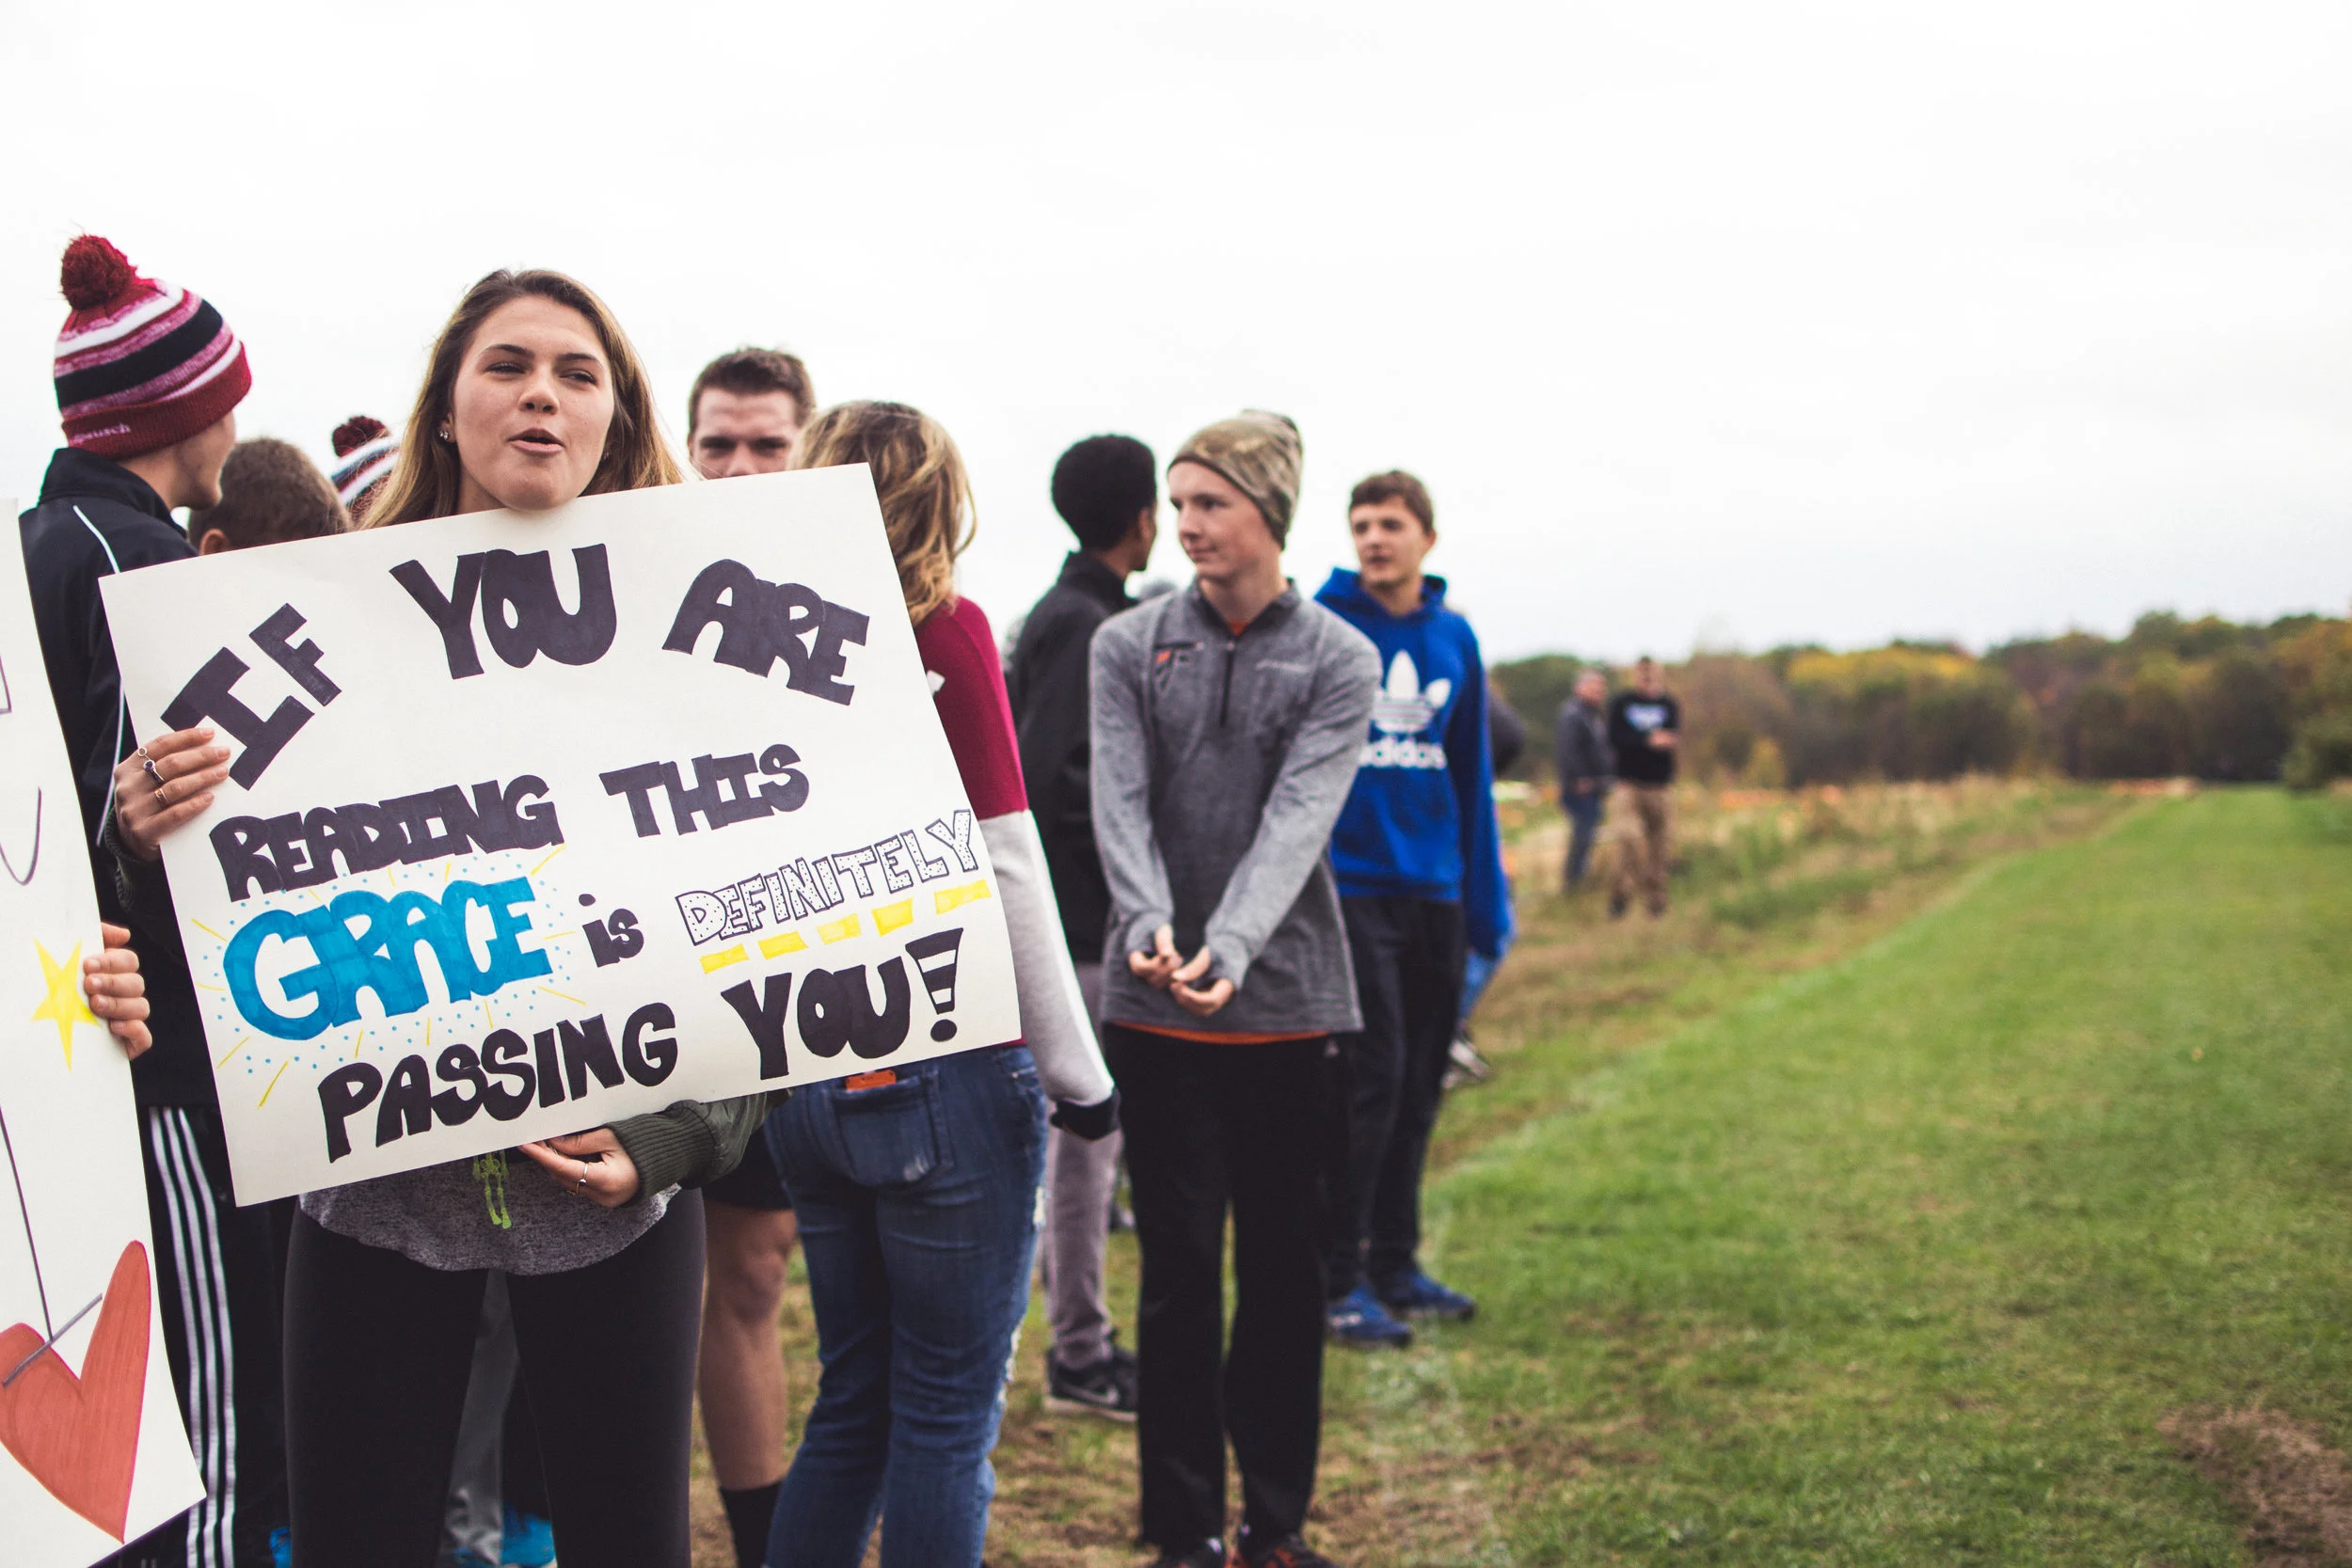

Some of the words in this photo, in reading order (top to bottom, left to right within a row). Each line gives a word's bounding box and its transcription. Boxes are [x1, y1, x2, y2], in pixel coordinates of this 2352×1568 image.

[160, 603, 342, 791] IF
[389, 544, 617, 679] YOU
[662, 559, 870, 705] ARE
[209, 775, 564, 902] READING
[599, 743, 810, 837] THIS
[223, 877, 553, 1040] GRACE
[675, 809, 979, 946] DEFINITELY
[317, 1003, 678, 1164] PASSING
[721, 927, 964, 1081] YOU!
